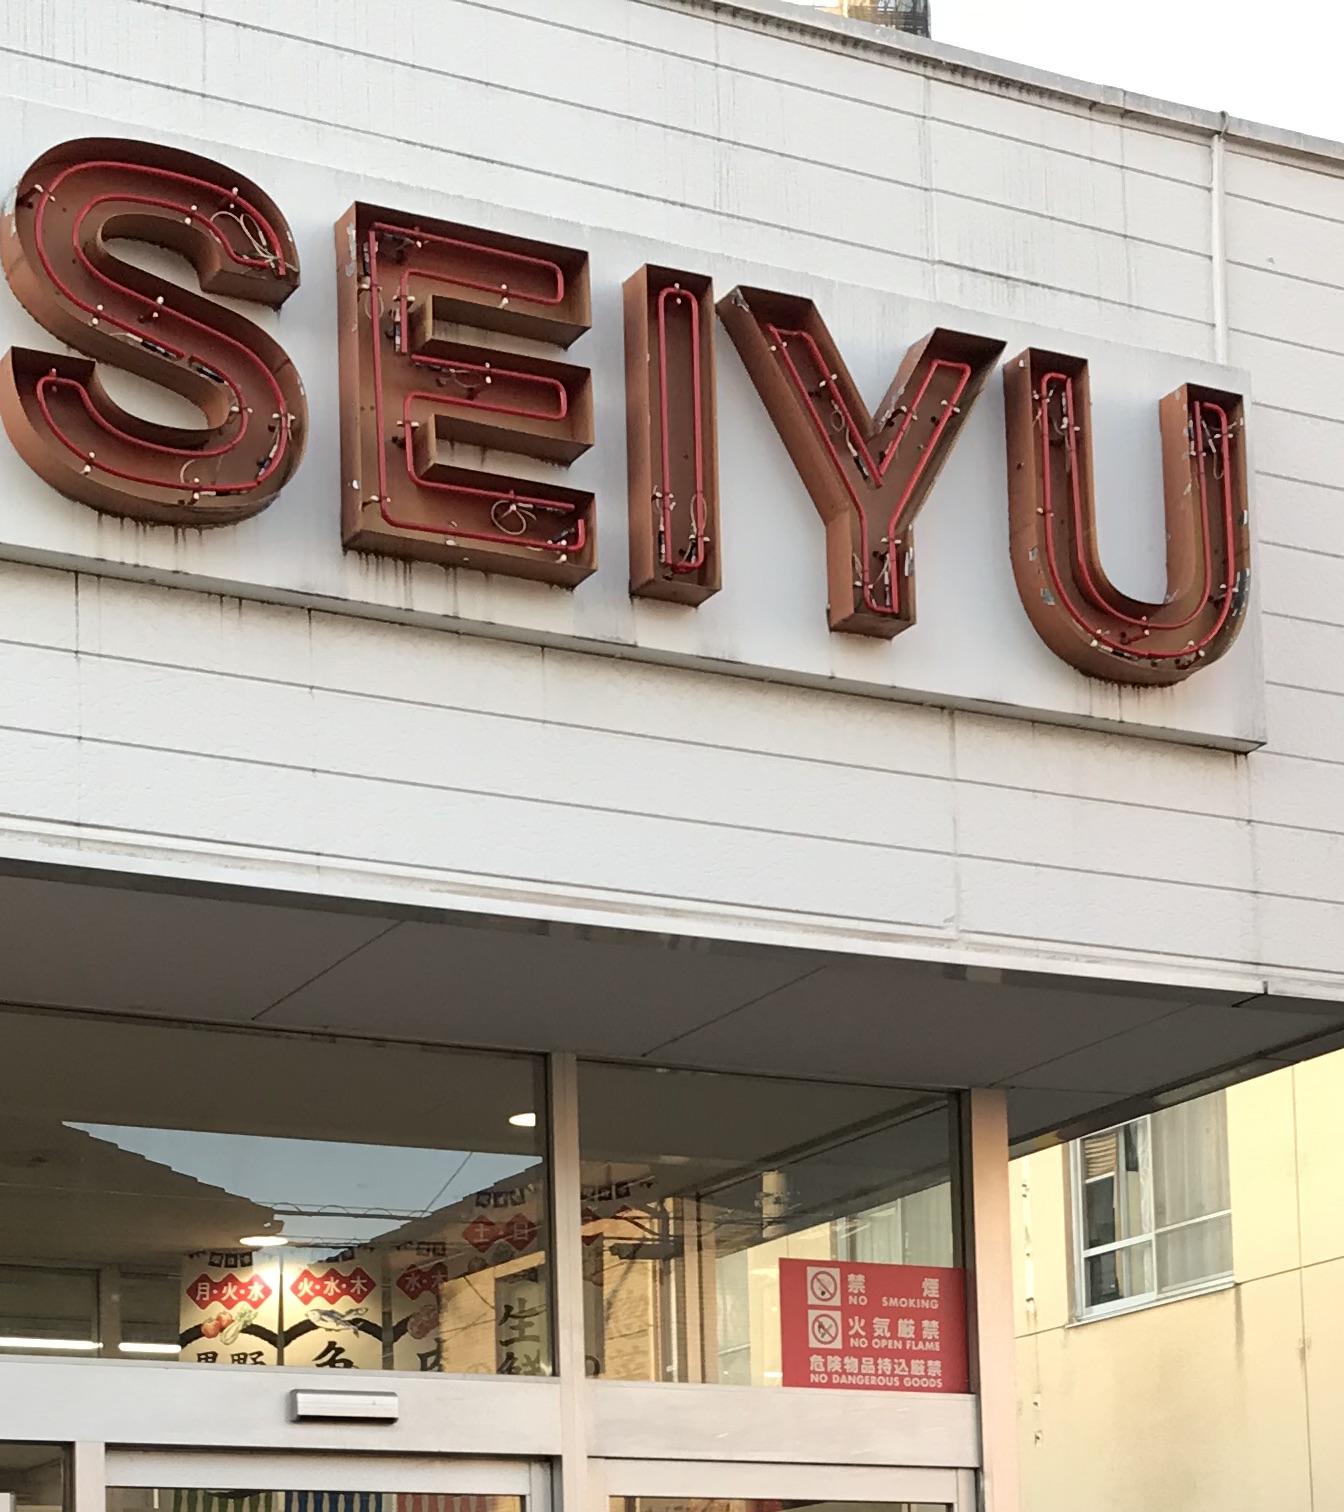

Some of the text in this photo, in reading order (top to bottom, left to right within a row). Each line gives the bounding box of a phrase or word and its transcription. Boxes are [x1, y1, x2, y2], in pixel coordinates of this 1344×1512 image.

[297, 1277, 368, 1298] 火・水・木
[848, 1296, 939, 1310] NO SMOKING
[848, 1315, 940, 1341] 火気厳禁
[850, 1338, 941, 1351] NO OPEN FLAME
[809, 1354, 943, 1377] 危険物品持込厳禁
[810, 1373, 943, 1389] NO DANGEROUS GOODS
